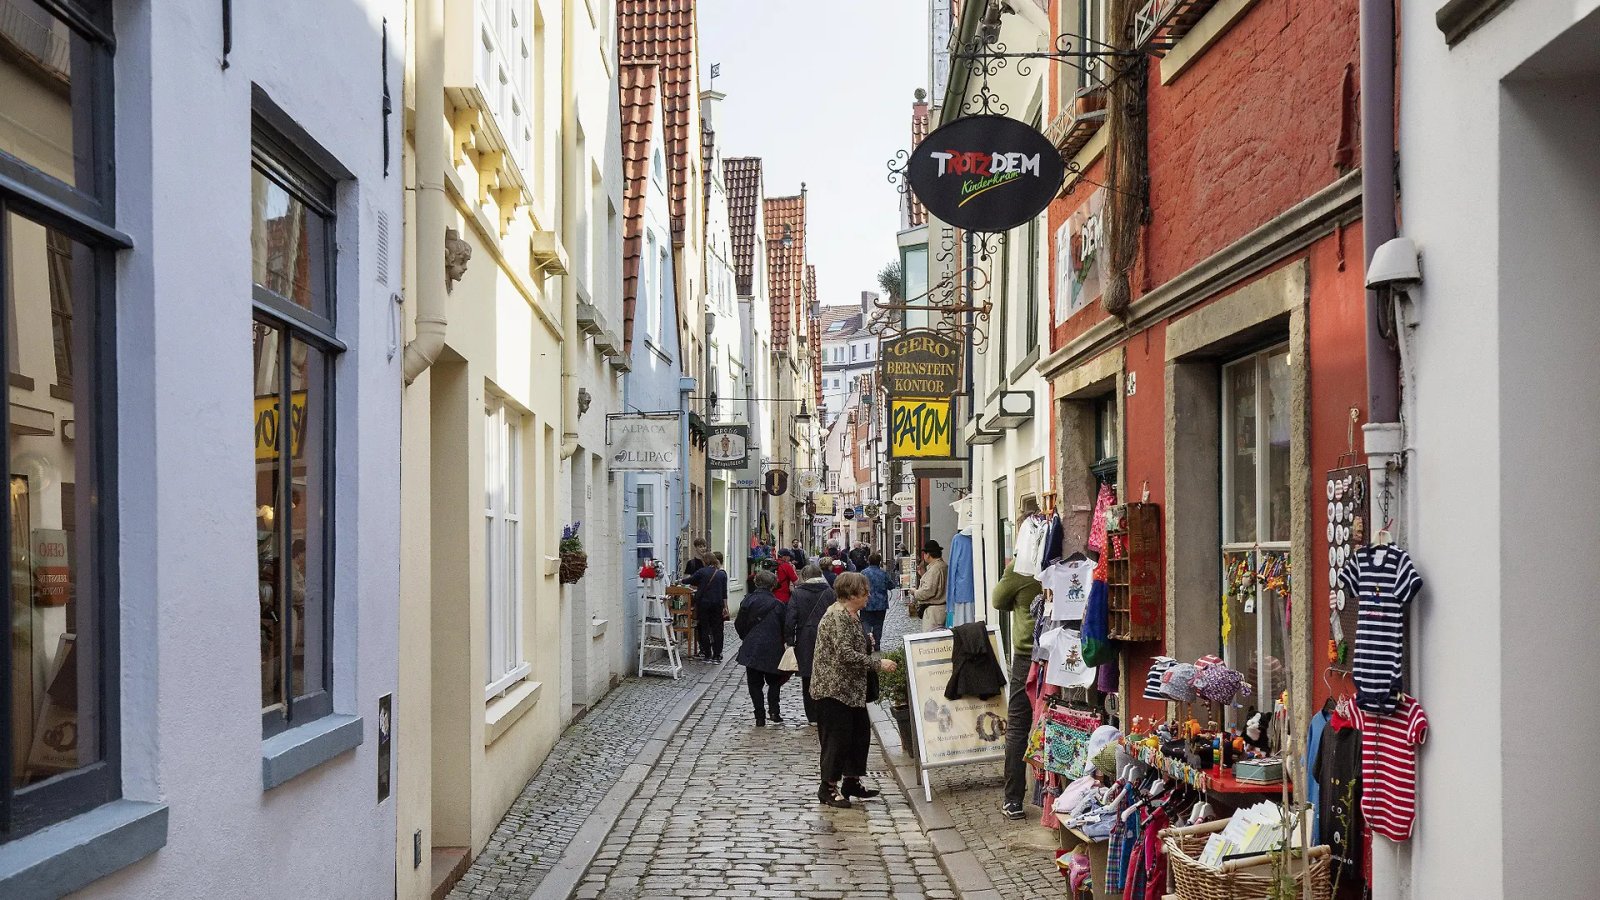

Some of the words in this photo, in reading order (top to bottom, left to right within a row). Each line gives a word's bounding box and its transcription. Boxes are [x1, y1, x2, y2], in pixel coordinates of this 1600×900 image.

[930, 151, 1041, 178] TROTZDEM
[961, 170, 1019, 195] Kinderkram
[894, 337, 949, 358] GERO
[887, 362, 955, 377] BERNSTEIN
[894, 378, 945, 393] KONTOR
[622, 424, 666, 434] ALPACA
[893, 402, 951, 451] PATOM
[935, 480, 954, 491] bpc
